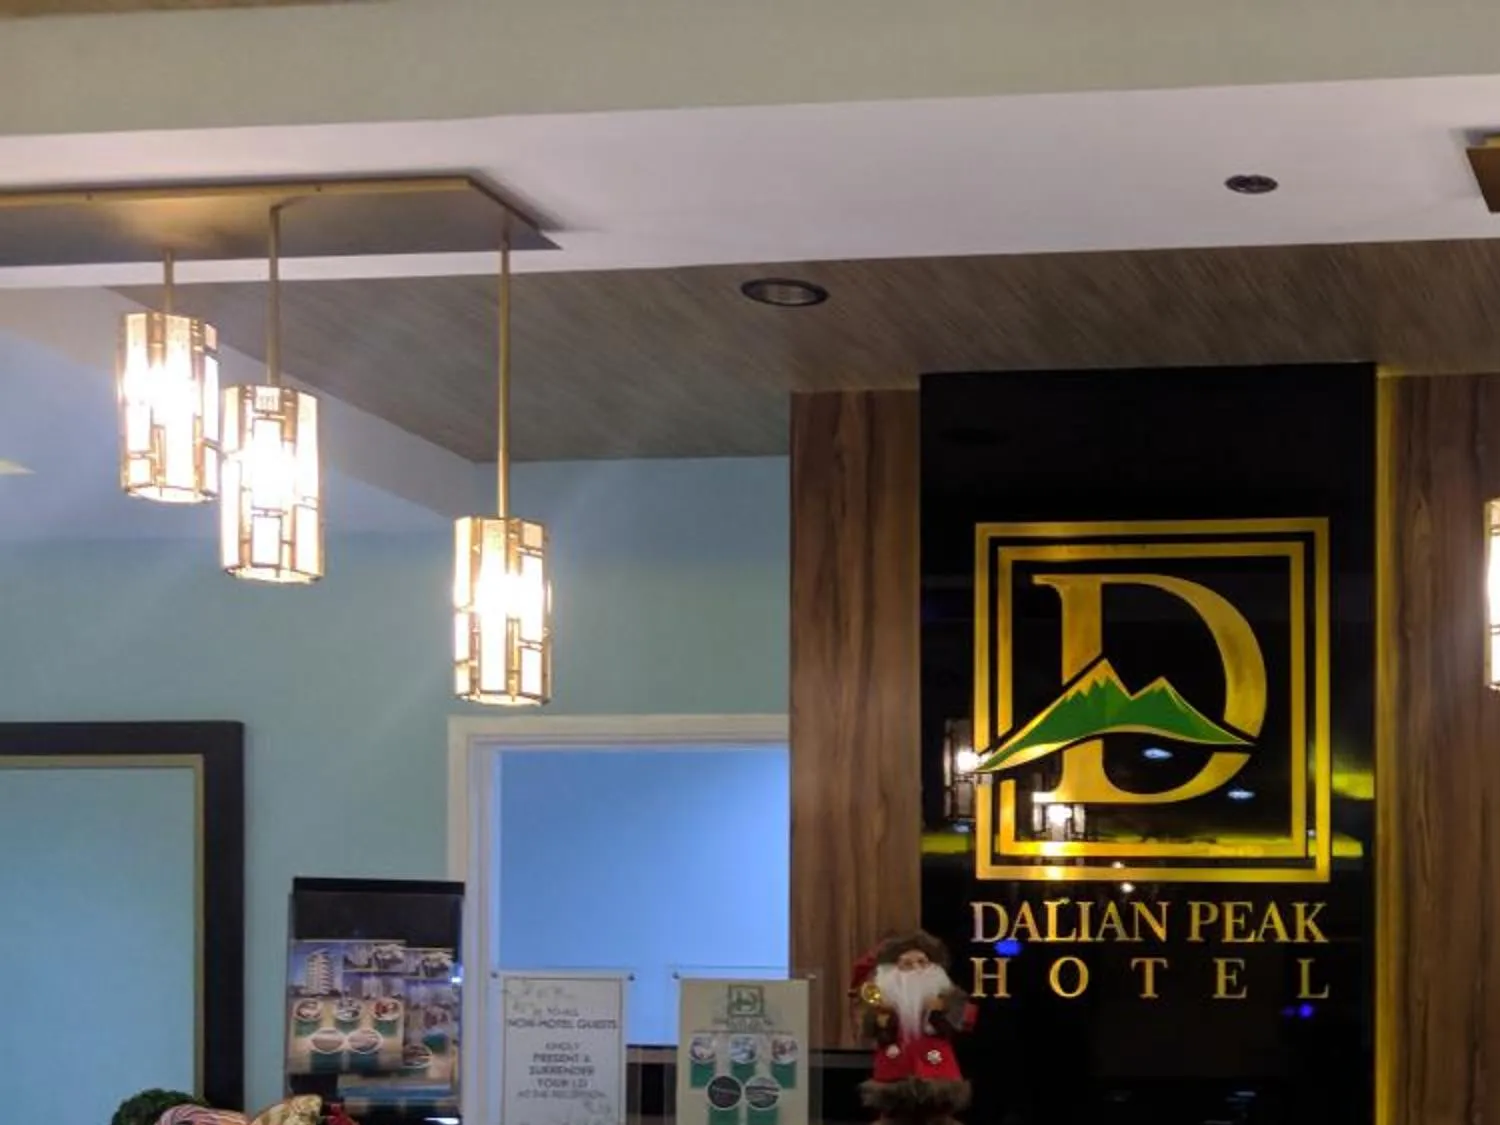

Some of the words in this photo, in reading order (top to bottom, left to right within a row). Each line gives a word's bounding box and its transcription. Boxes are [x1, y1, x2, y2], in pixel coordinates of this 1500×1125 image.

[970, 901, 1169, 943] DALIAN
[1186, 901, 1330, 944] PEAK
[970, 956, 1330, 999] HOTEL
